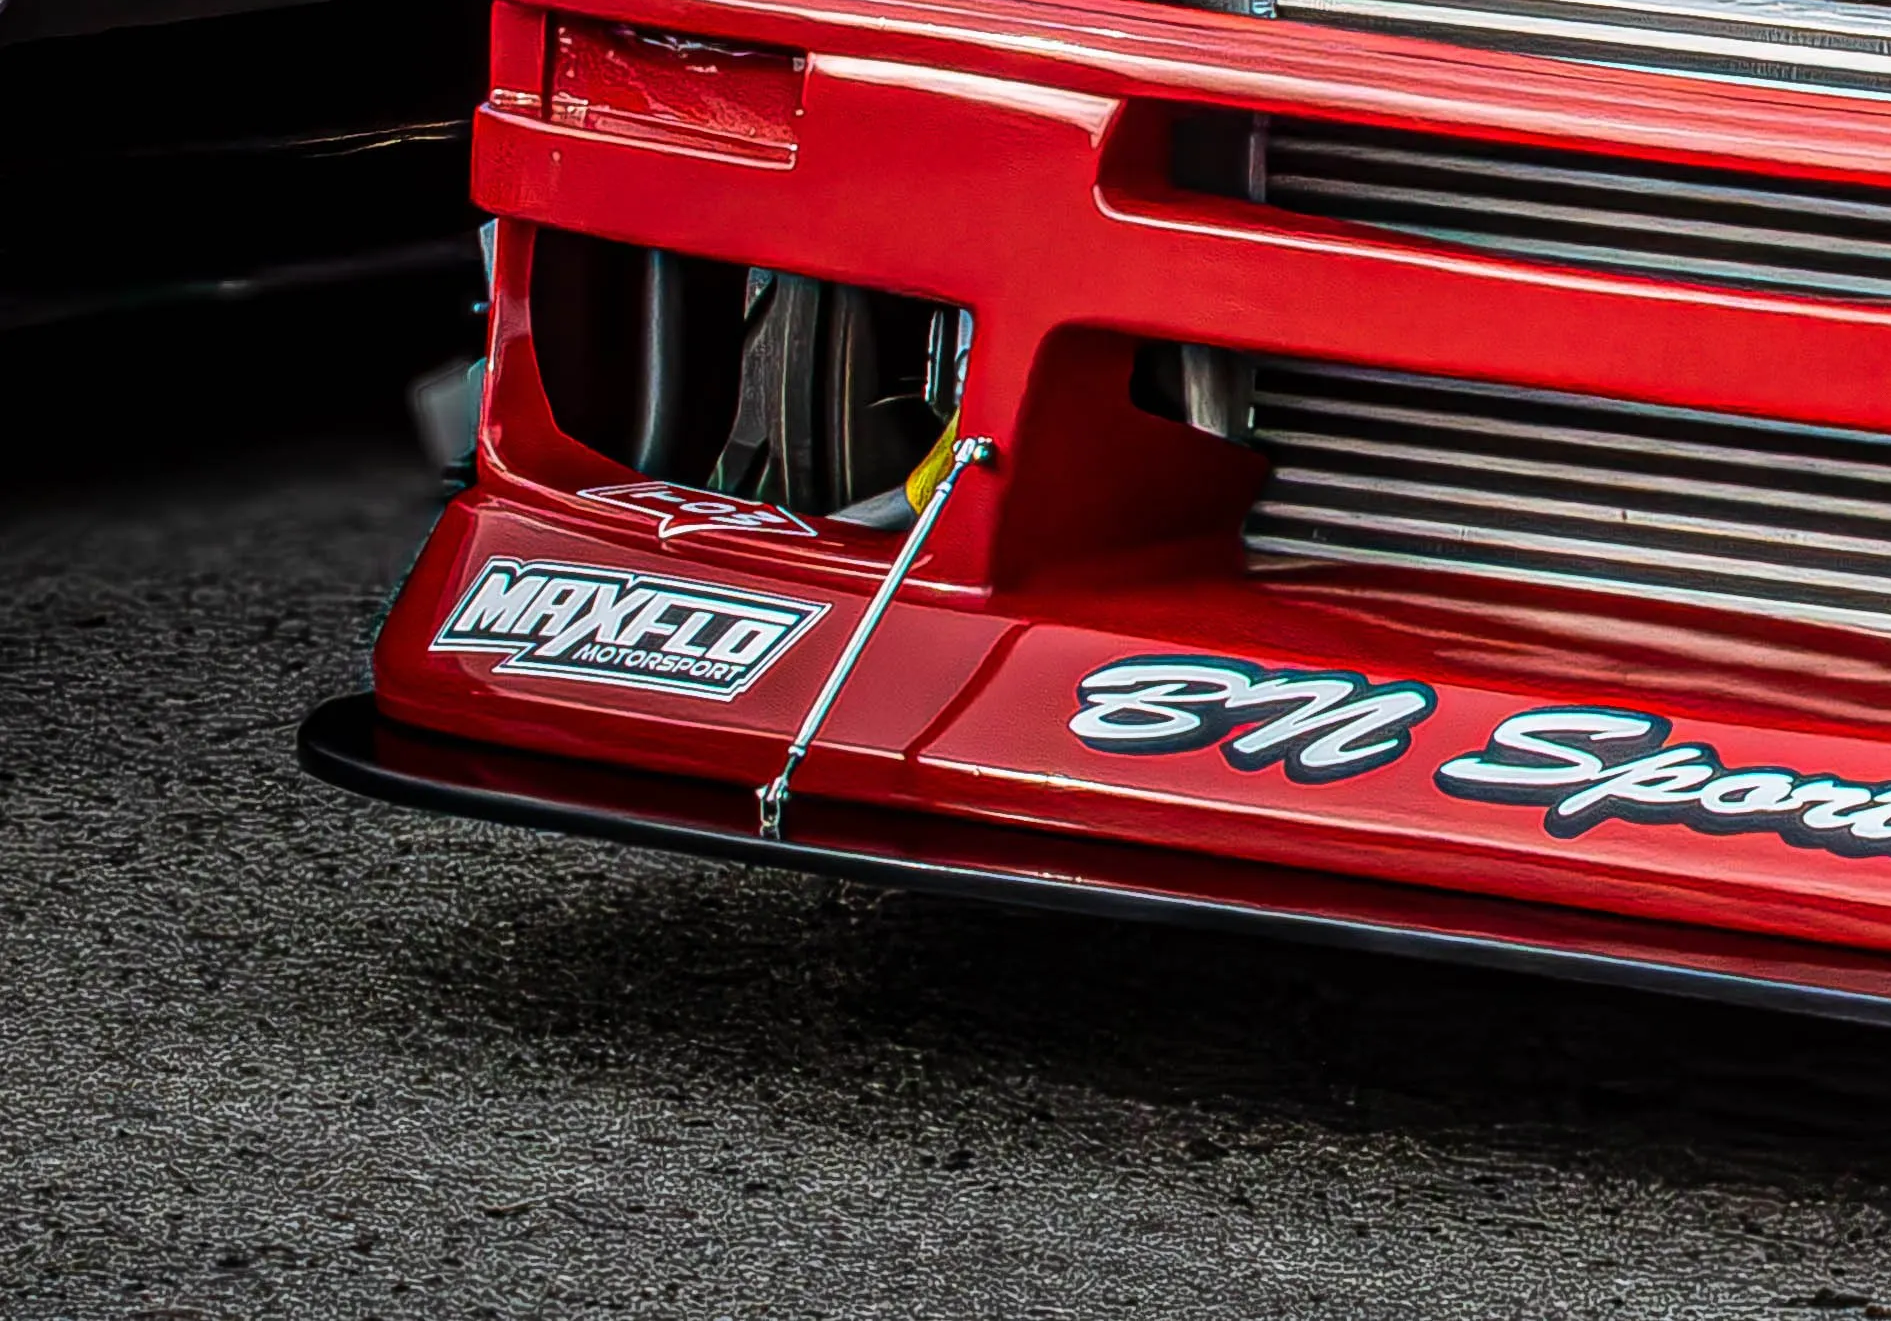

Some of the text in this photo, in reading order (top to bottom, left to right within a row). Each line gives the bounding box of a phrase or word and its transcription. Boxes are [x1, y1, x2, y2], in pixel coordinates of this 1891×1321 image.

[453, 570, 797, 666] MAXFLO
[577, 643, 746, 683] MOTORSPORT
[1067, 662, 1421, 768] BN
